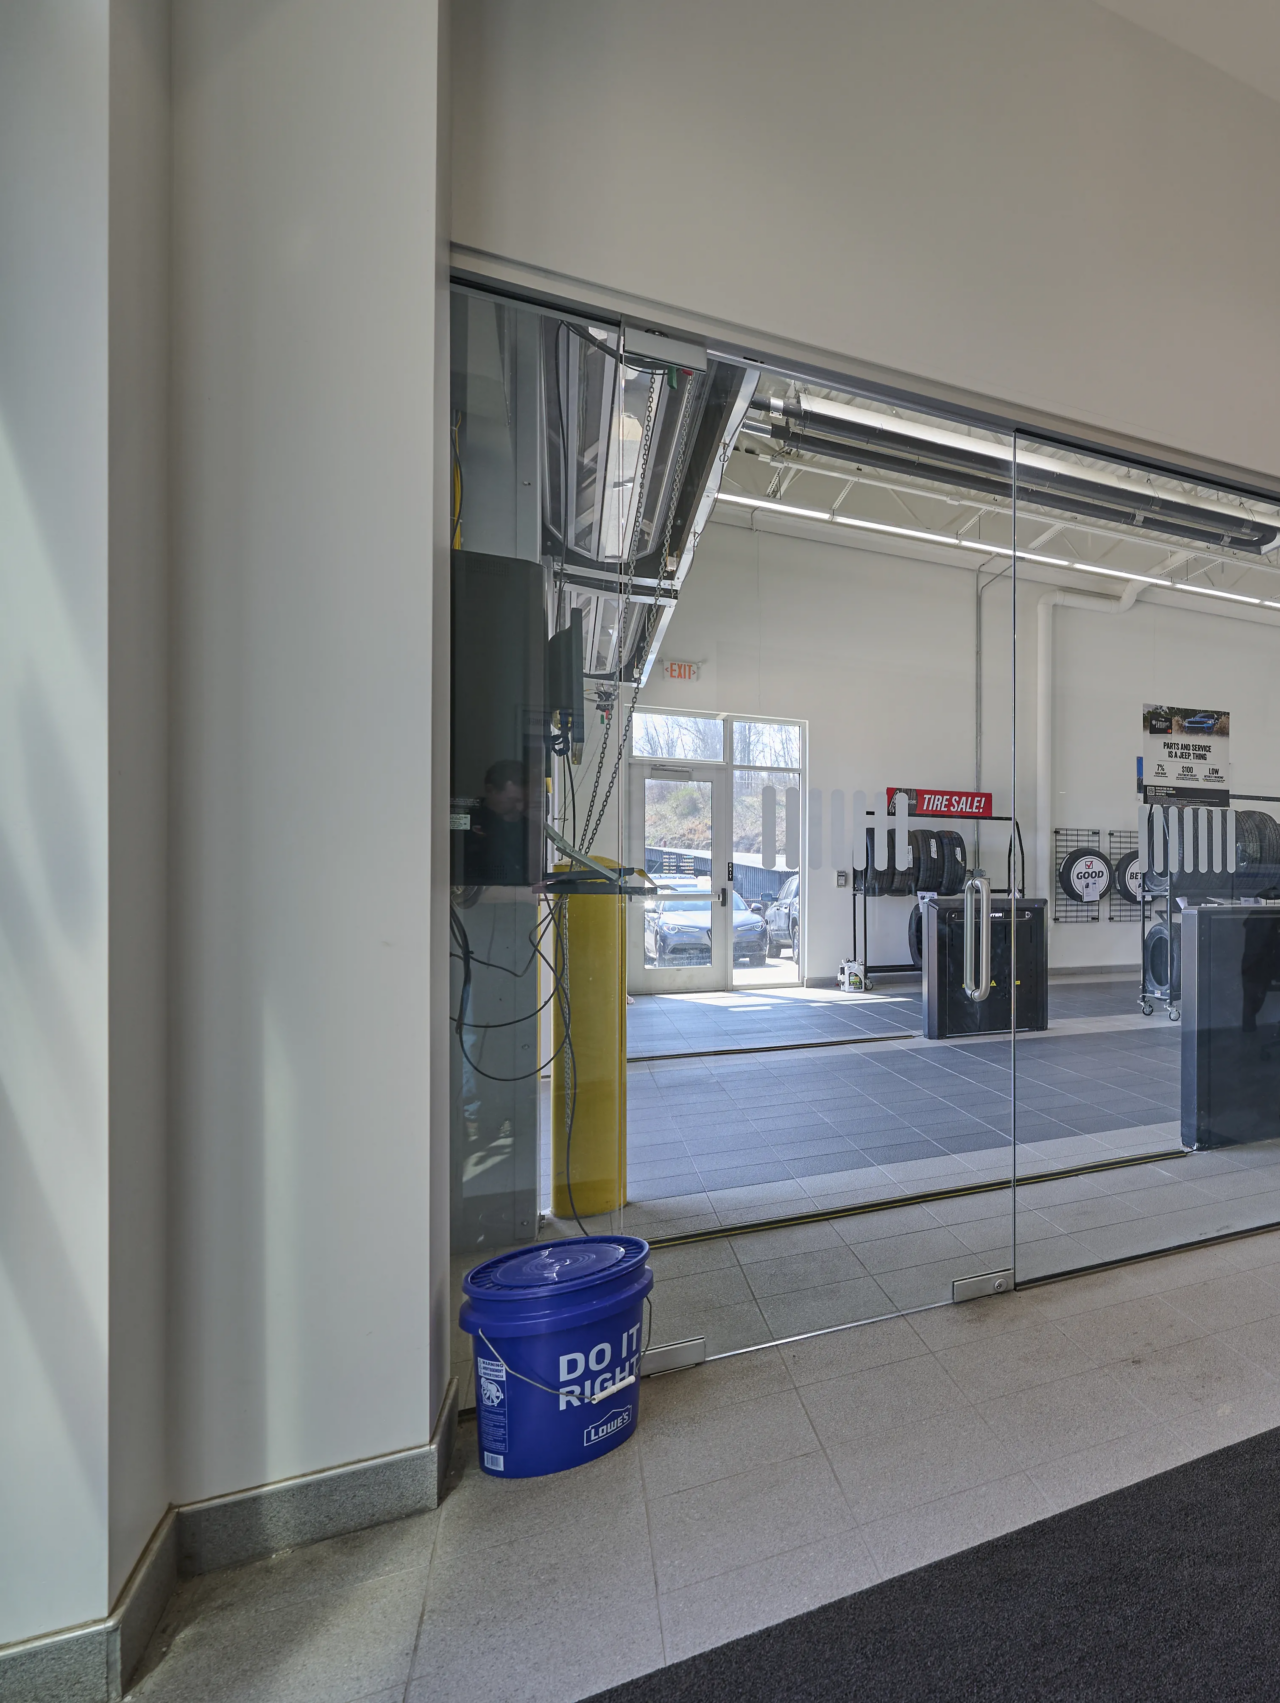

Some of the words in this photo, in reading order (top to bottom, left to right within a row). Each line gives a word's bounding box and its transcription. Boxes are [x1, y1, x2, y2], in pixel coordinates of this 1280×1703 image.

[669, 662, 693, 679] EXIT
[1163, 741, 1180, 750] PARTS
[1180, 743, 1191, 751] AND
[1191, 744, 1212, 753] SERVICE
[1168, 750, 1173, 758] IS
[1192, 752, 1207, 761] THING
[1156, 763, 1165, 771] 7%
[1181, 765, 1194, 774] $100
[1208, 767, 1220, 775] LOW
[923, 794, 950, 811] TIRE
[950, 796, 985, 813] SALE!
[1076, 870, 1104, 880] GOOD
[559, 1342, 612, 1382] DO
[621, 1321, 640, 1359] IT
[559, 1352, 640, 1411] RIGHT
[590, 1411, 629, 1441] LOWE'S
